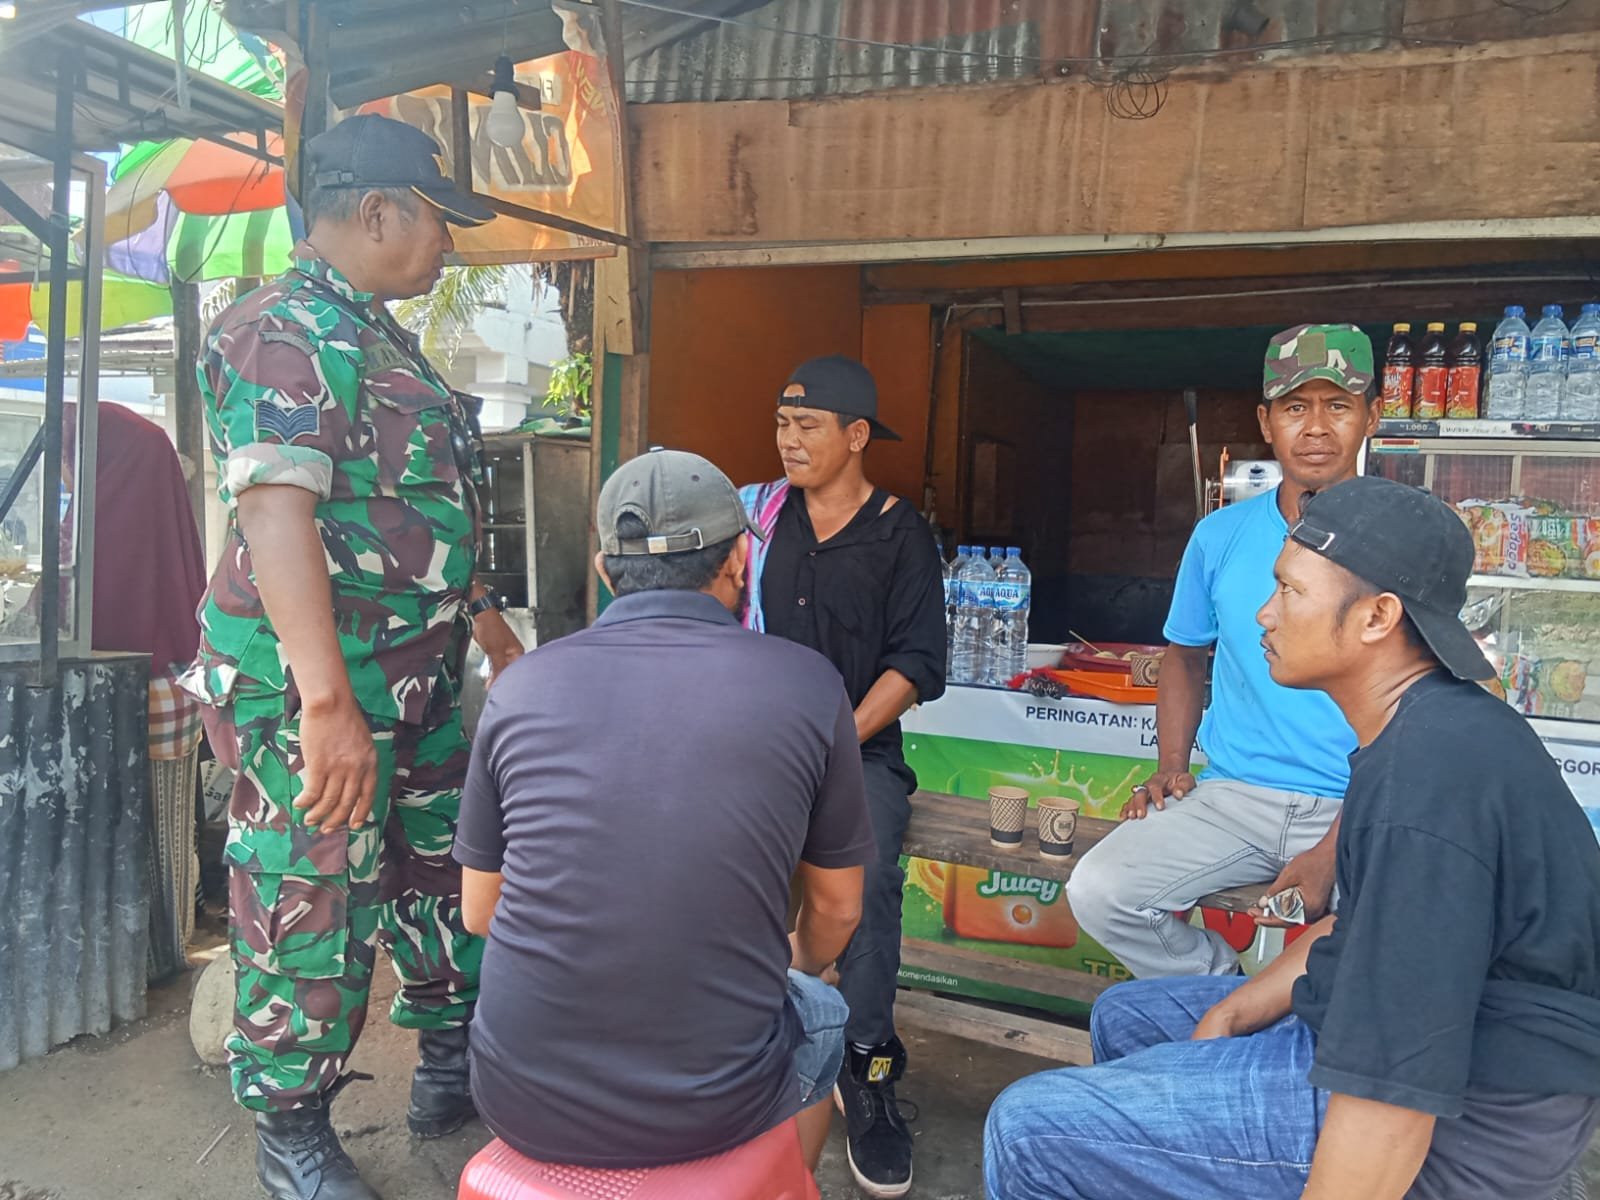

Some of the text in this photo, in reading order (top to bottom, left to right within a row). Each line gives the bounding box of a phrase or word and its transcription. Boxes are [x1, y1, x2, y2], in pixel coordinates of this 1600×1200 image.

[995, 588, 1019, 599] AQUA
[1026, 705, 1138, 728] PERINGATAN:
[980, 871, 1059, 902] Juicy
